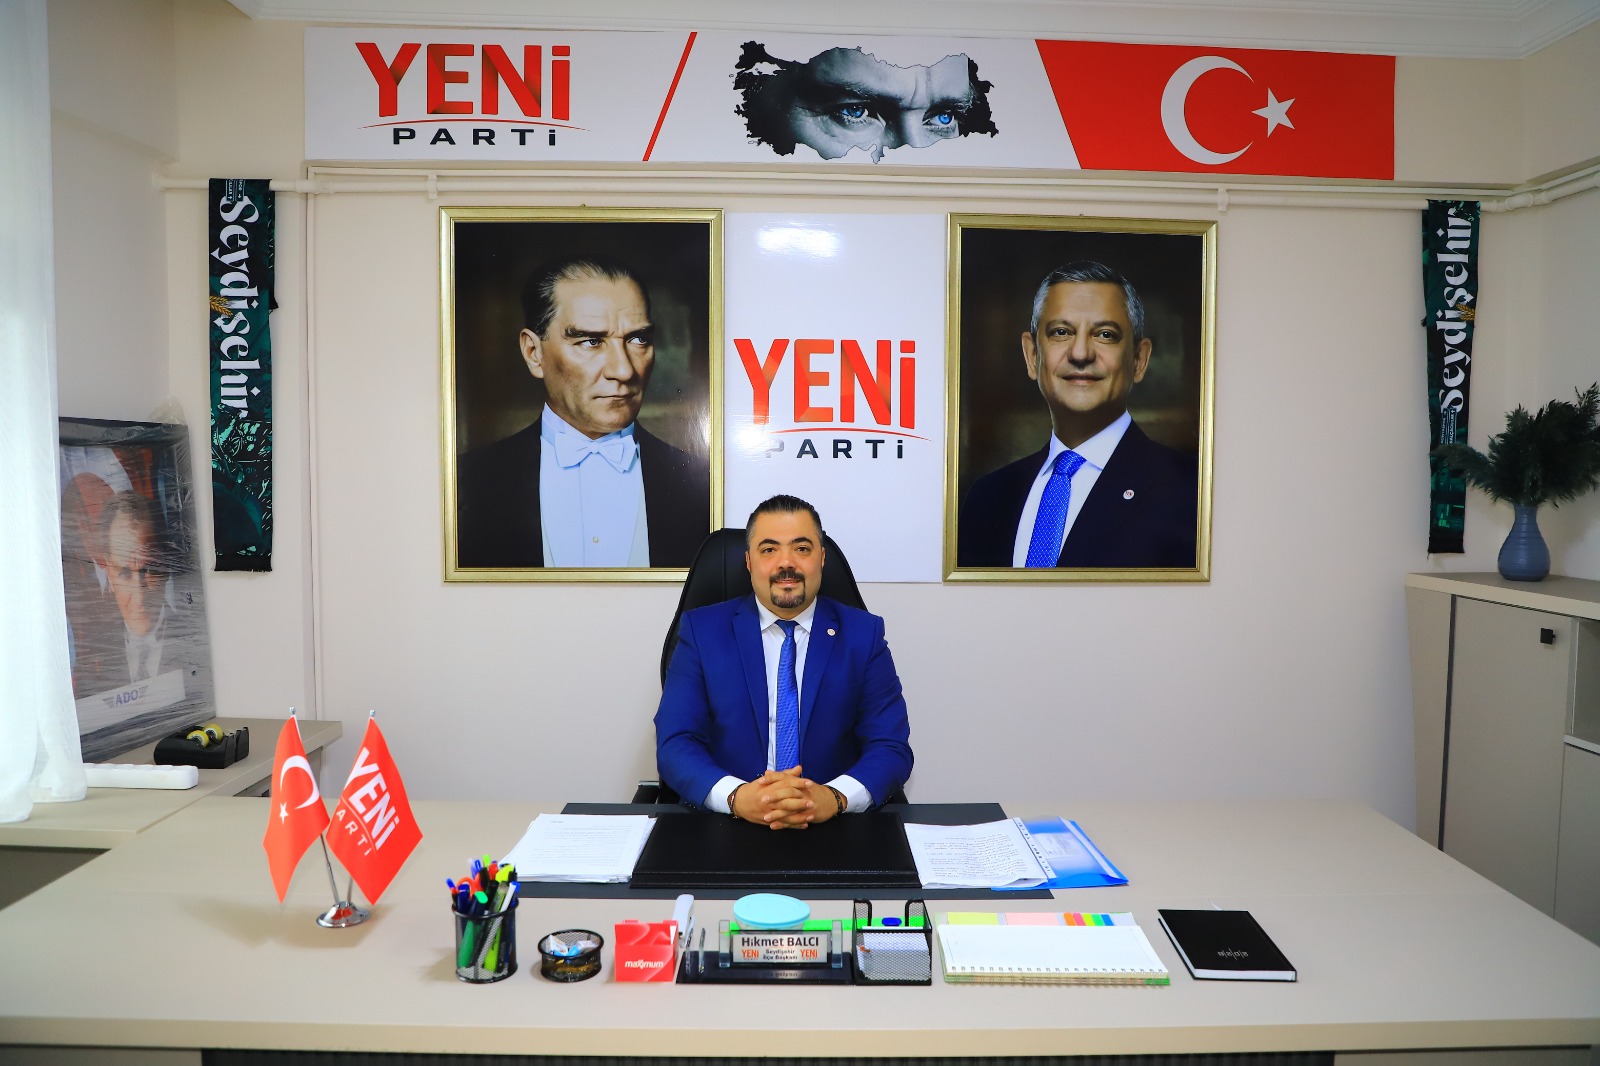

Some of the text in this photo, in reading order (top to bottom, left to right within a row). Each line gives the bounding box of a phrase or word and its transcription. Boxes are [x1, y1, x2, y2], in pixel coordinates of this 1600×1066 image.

[210, 195, 261, 419] Seydişehir
[1436, 207, 1475, 413] Seydişehir
[336, 809, 373, 856] ARTi
[741, 936, 819, 947] Hikmet BALCI
